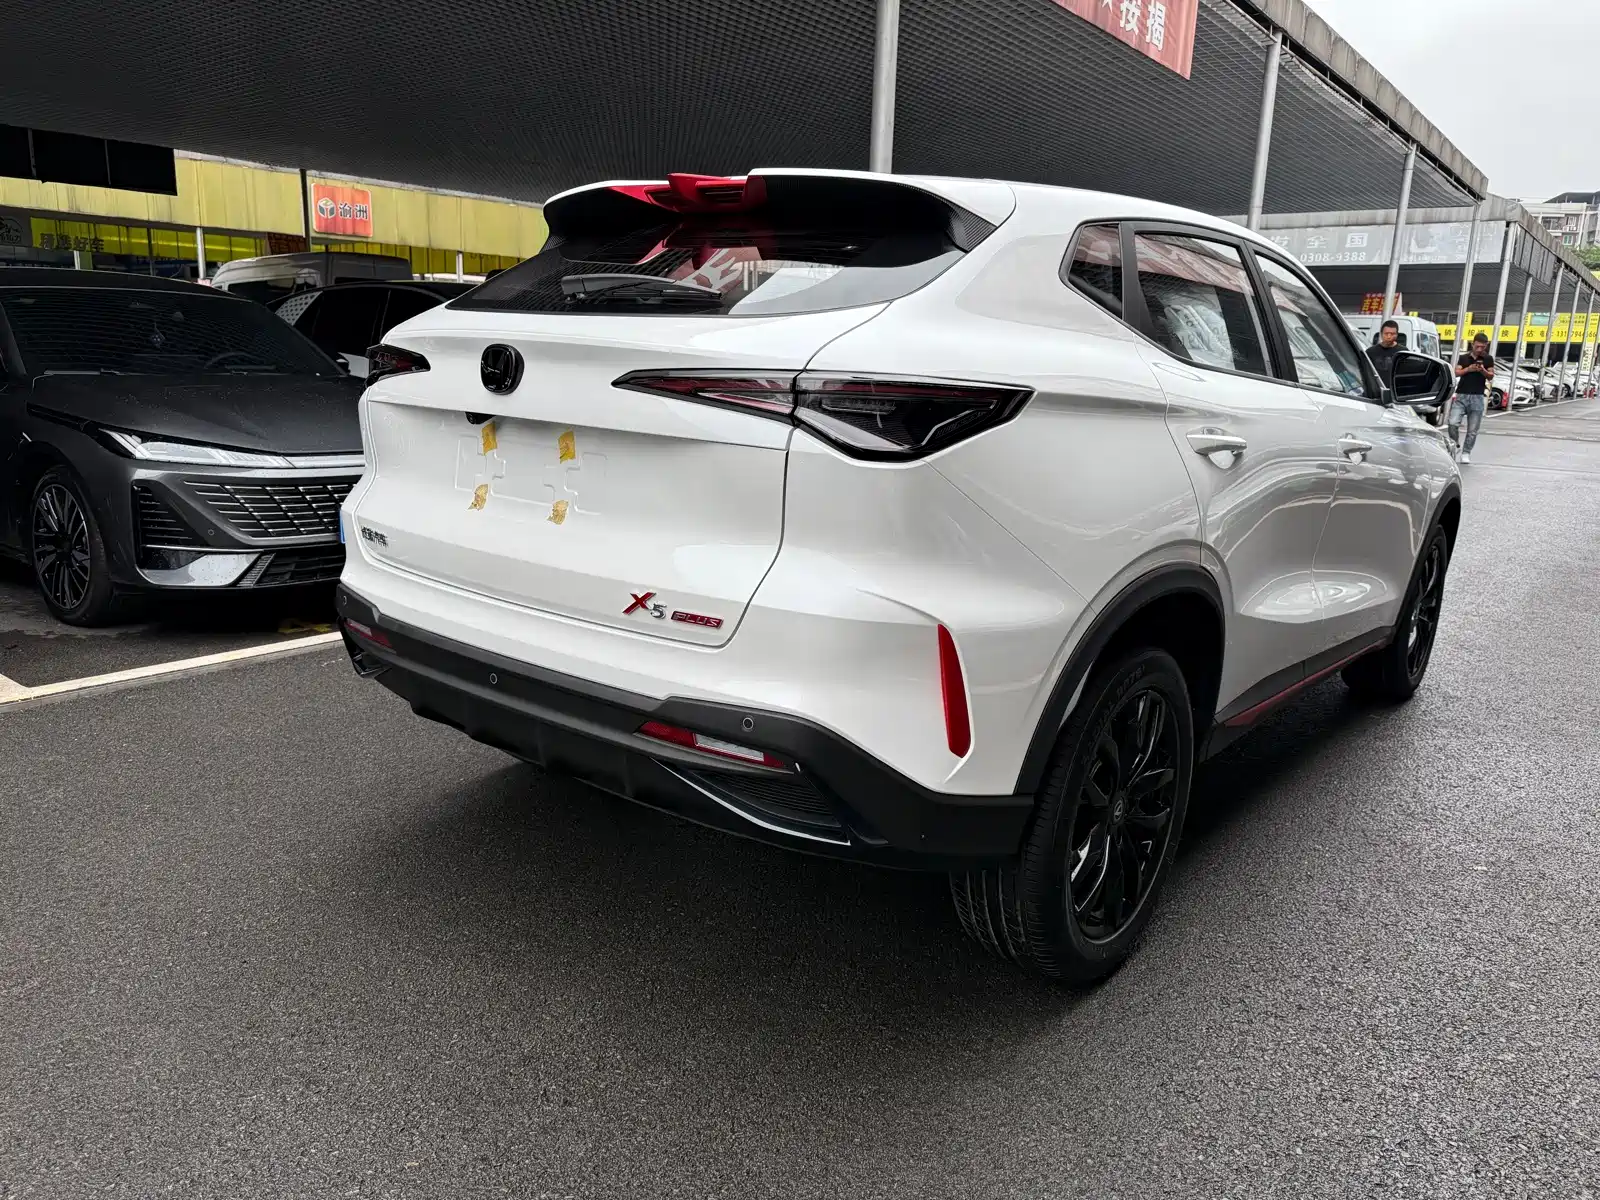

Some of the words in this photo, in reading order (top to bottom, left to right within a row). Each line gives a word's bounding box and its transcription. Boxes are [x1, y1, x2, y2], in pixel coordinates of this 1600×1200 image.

[1101, 0, 1166, 51] 按揭
[338, 203, 369, 220] 渝洲
[672, 611, 721, 628] PLUS
